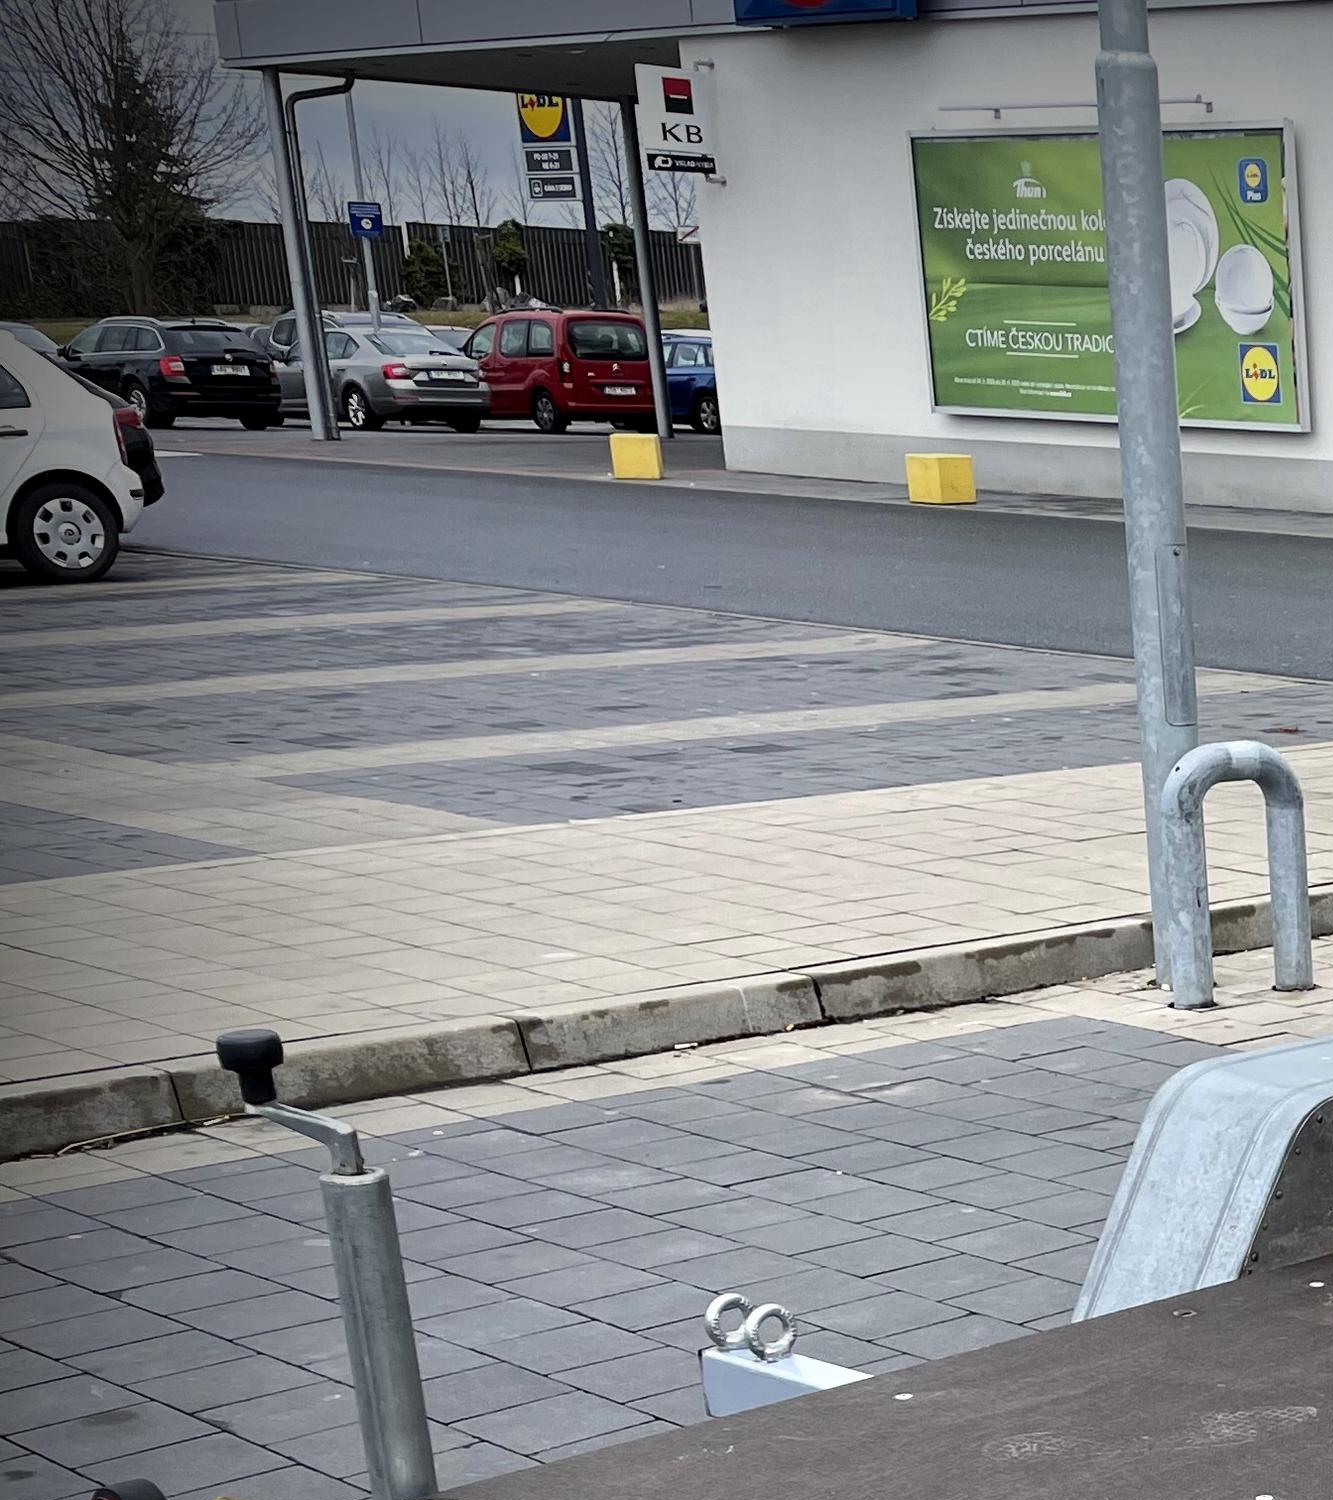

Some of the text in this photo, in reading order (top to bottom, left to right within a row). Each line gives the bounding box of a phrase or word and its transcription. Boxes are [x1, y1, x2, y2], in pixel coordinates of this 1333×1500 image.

[661, 122, 703, 144] KB
[933, 206, 1106, 235] Získejte jedinečnou kol
[966, 238, 1105, 267] českého porcelánu
[965, 325, 1115, 354] CTÍME ČESKOU TRADIC
